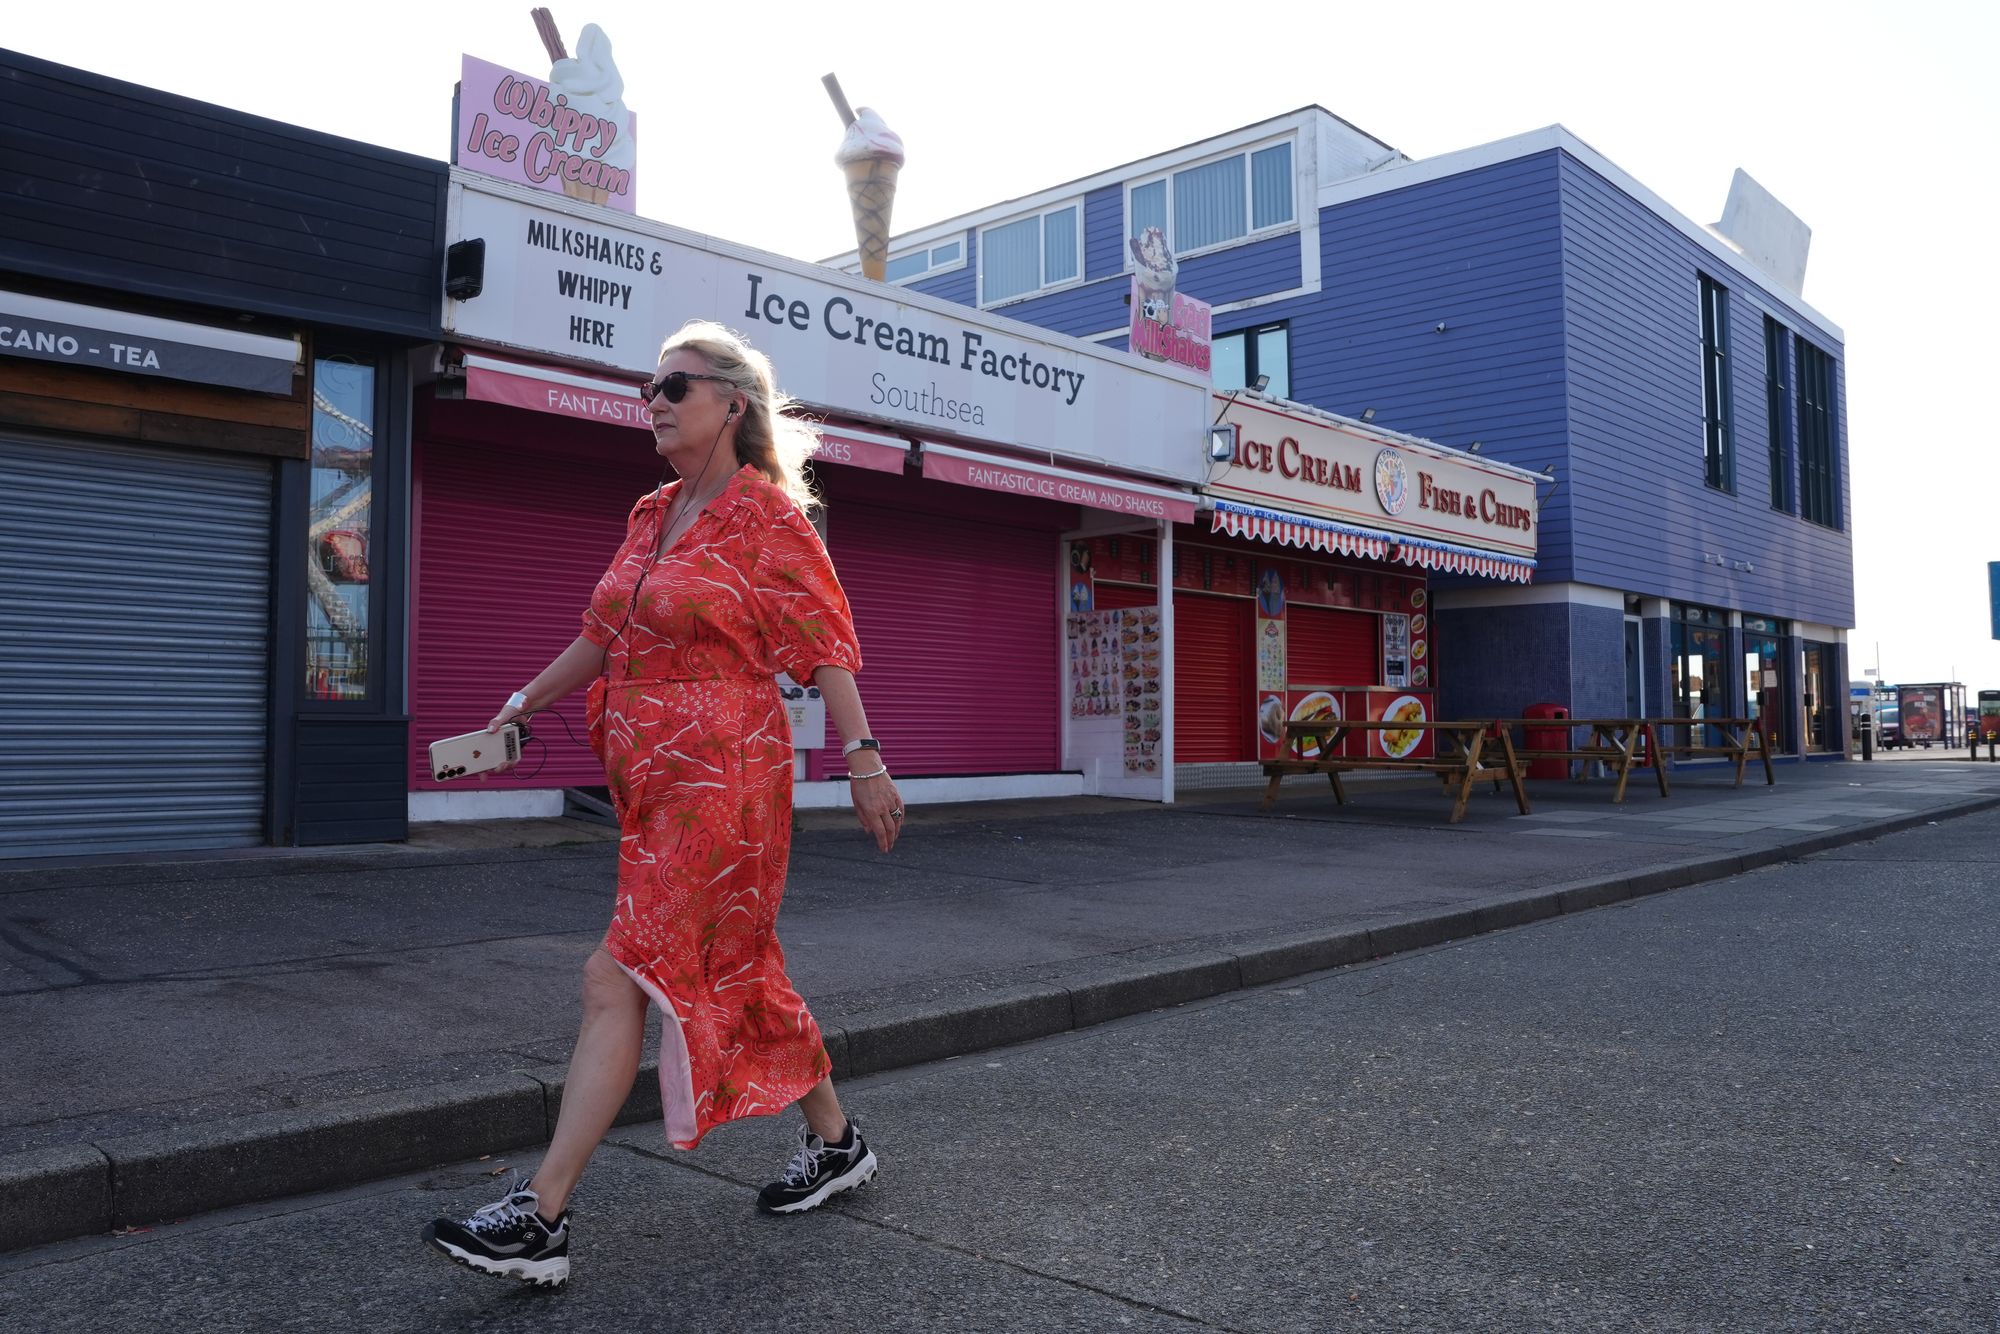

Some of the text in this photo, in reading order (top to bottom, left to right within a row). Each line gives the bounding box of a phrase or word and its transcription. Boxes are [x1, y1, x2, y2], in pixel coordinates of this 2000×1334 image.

[494, 75, 617, 157] Whippy
[467, 113, 630, 195] Ice Cream
[527, 219, 663, 276] MILKSHAKES &
[558, 270, 632, 310] WHIPPY
[0, 326, 79, 356] CANO
[110, 343, 160, 369] TEA
[570, 315, 615, 349] HERE
[745, 273, 1085, 406] Ice Cream Factory
[548, 389, 652, 425] FANTASTIC
[871, 372, 985, 426] Southsea
[968, 466, 1164, 516] FANTASTIC ICE CREAM AND SHAKES
[1231, 422, 1531, 532] ICE CREAM FISH & CHIPS
[1224, 503, 1385, 540] DONUTS ICE CREAM FRESH GROUND COFFEE
